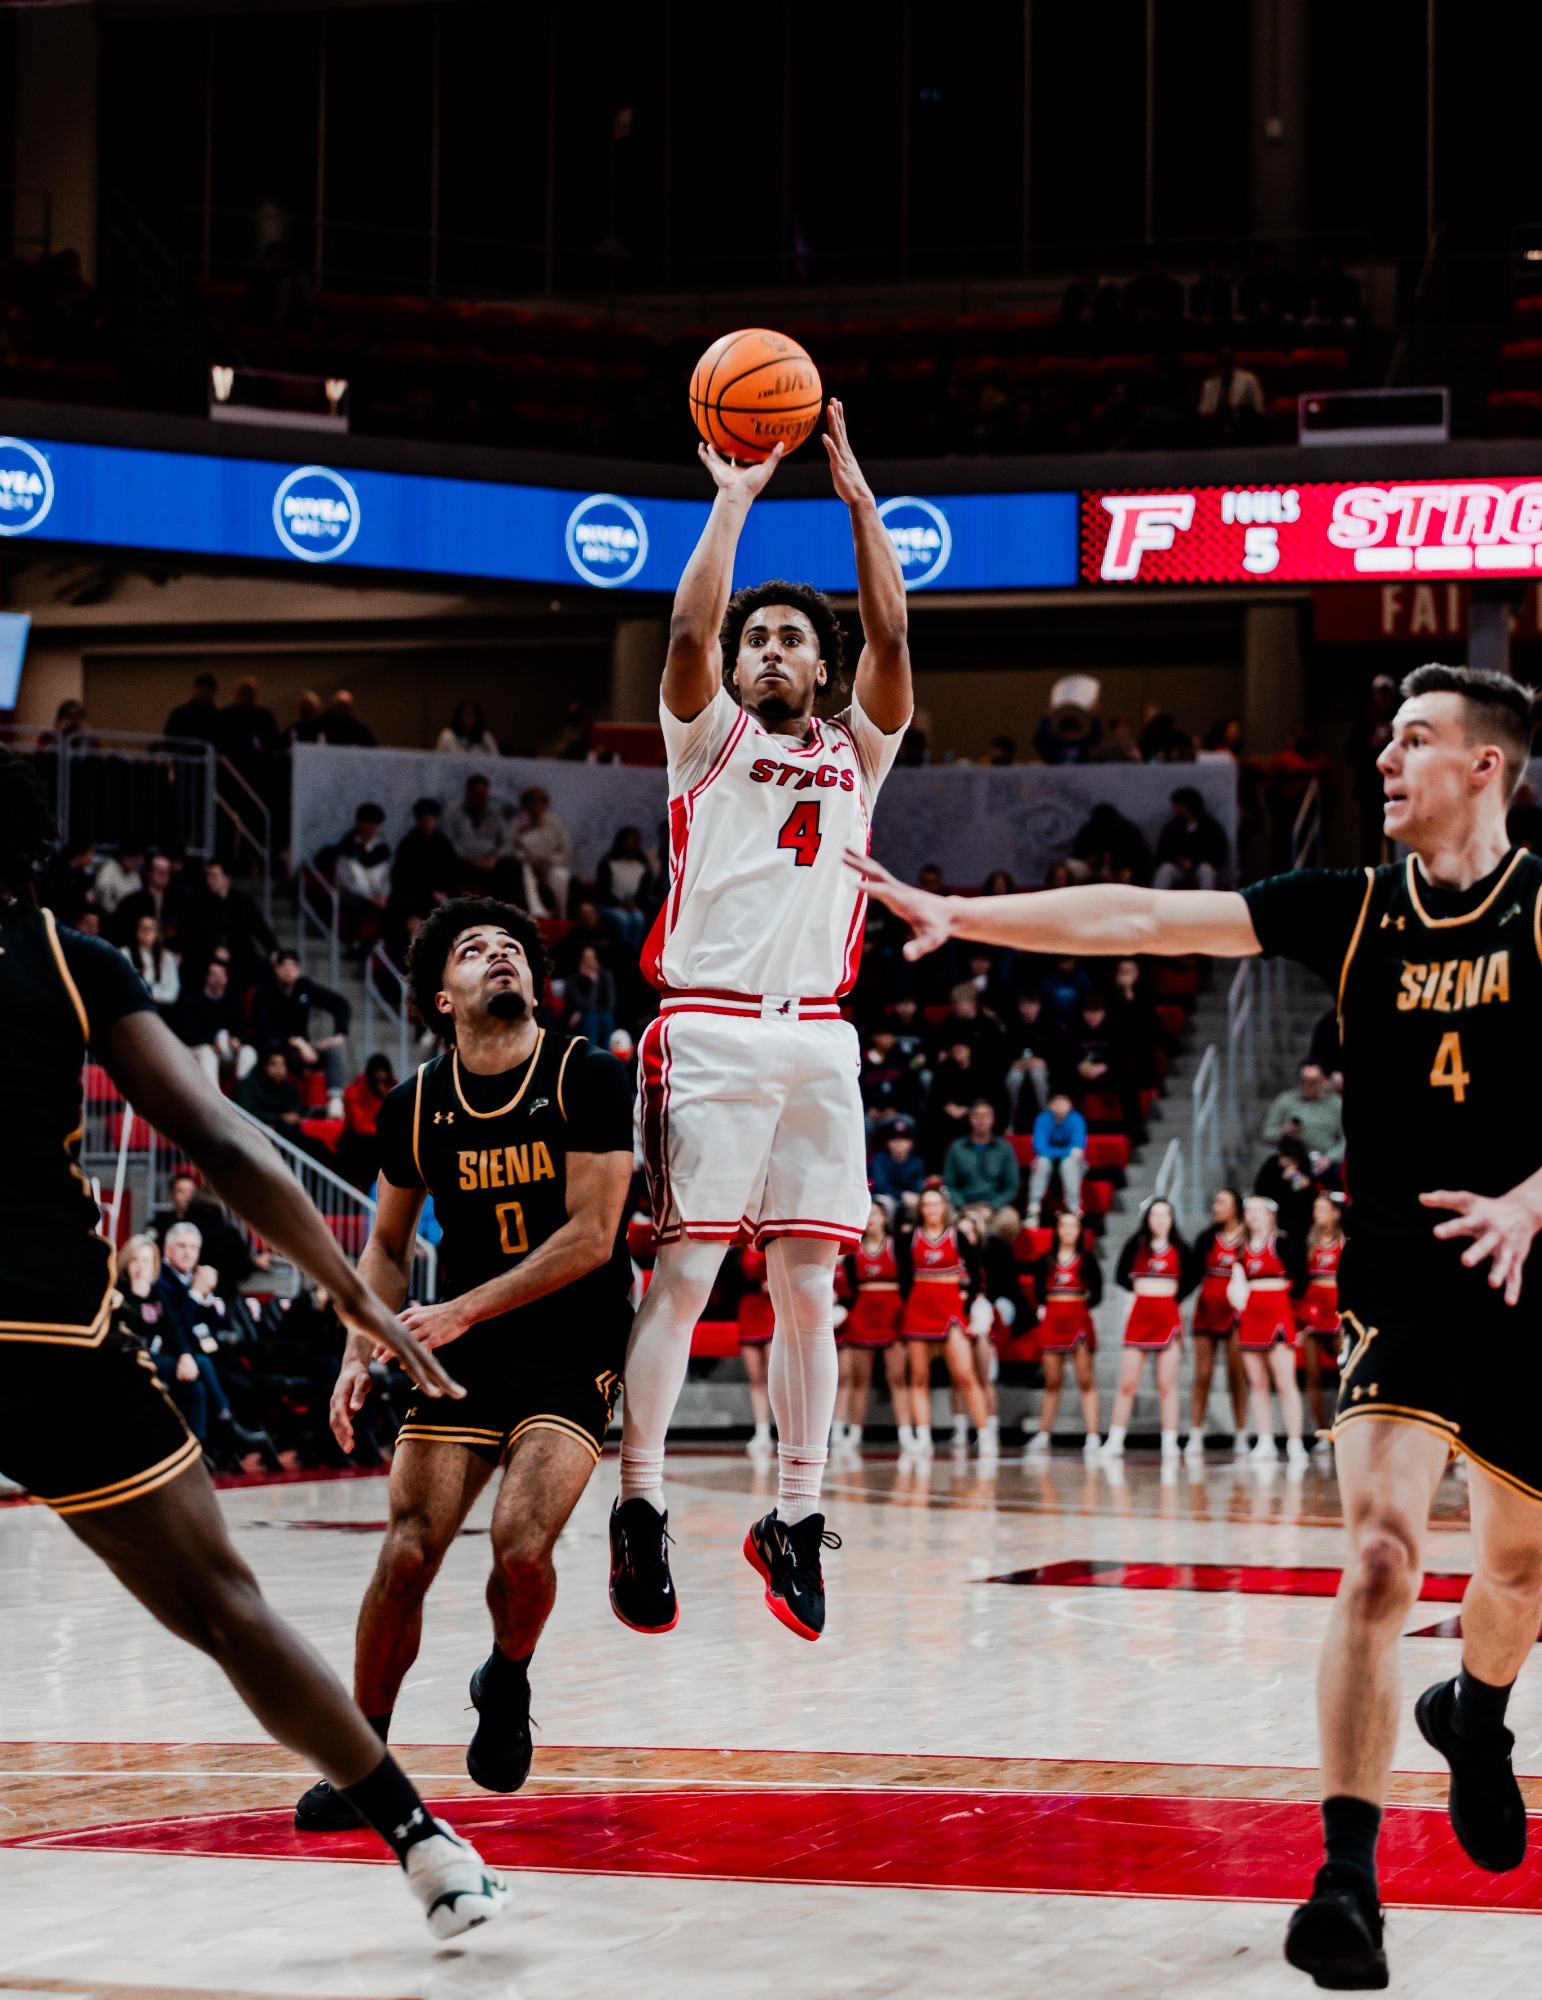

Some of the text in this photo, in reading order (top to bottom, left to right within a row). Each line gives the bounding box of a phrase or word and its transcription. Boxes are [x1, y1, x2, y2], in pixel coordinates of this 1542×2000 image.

[0, 469, 43, 495] VEA
[284, 496, 350, 522] NIVEA
[886, 527, 941, 549] IVEA
[1100, 494, 1196, 580] F
[1242, 526, 1280, 573] 5
[777, 800, 822, 867] 4
[1396, 949, 1511, 1013] SIENA
[1429, 1031, 1471, 1103] 4
[457, 1140, 556, 1191] SIENA
[495, 1201, 529, 1255] 0
